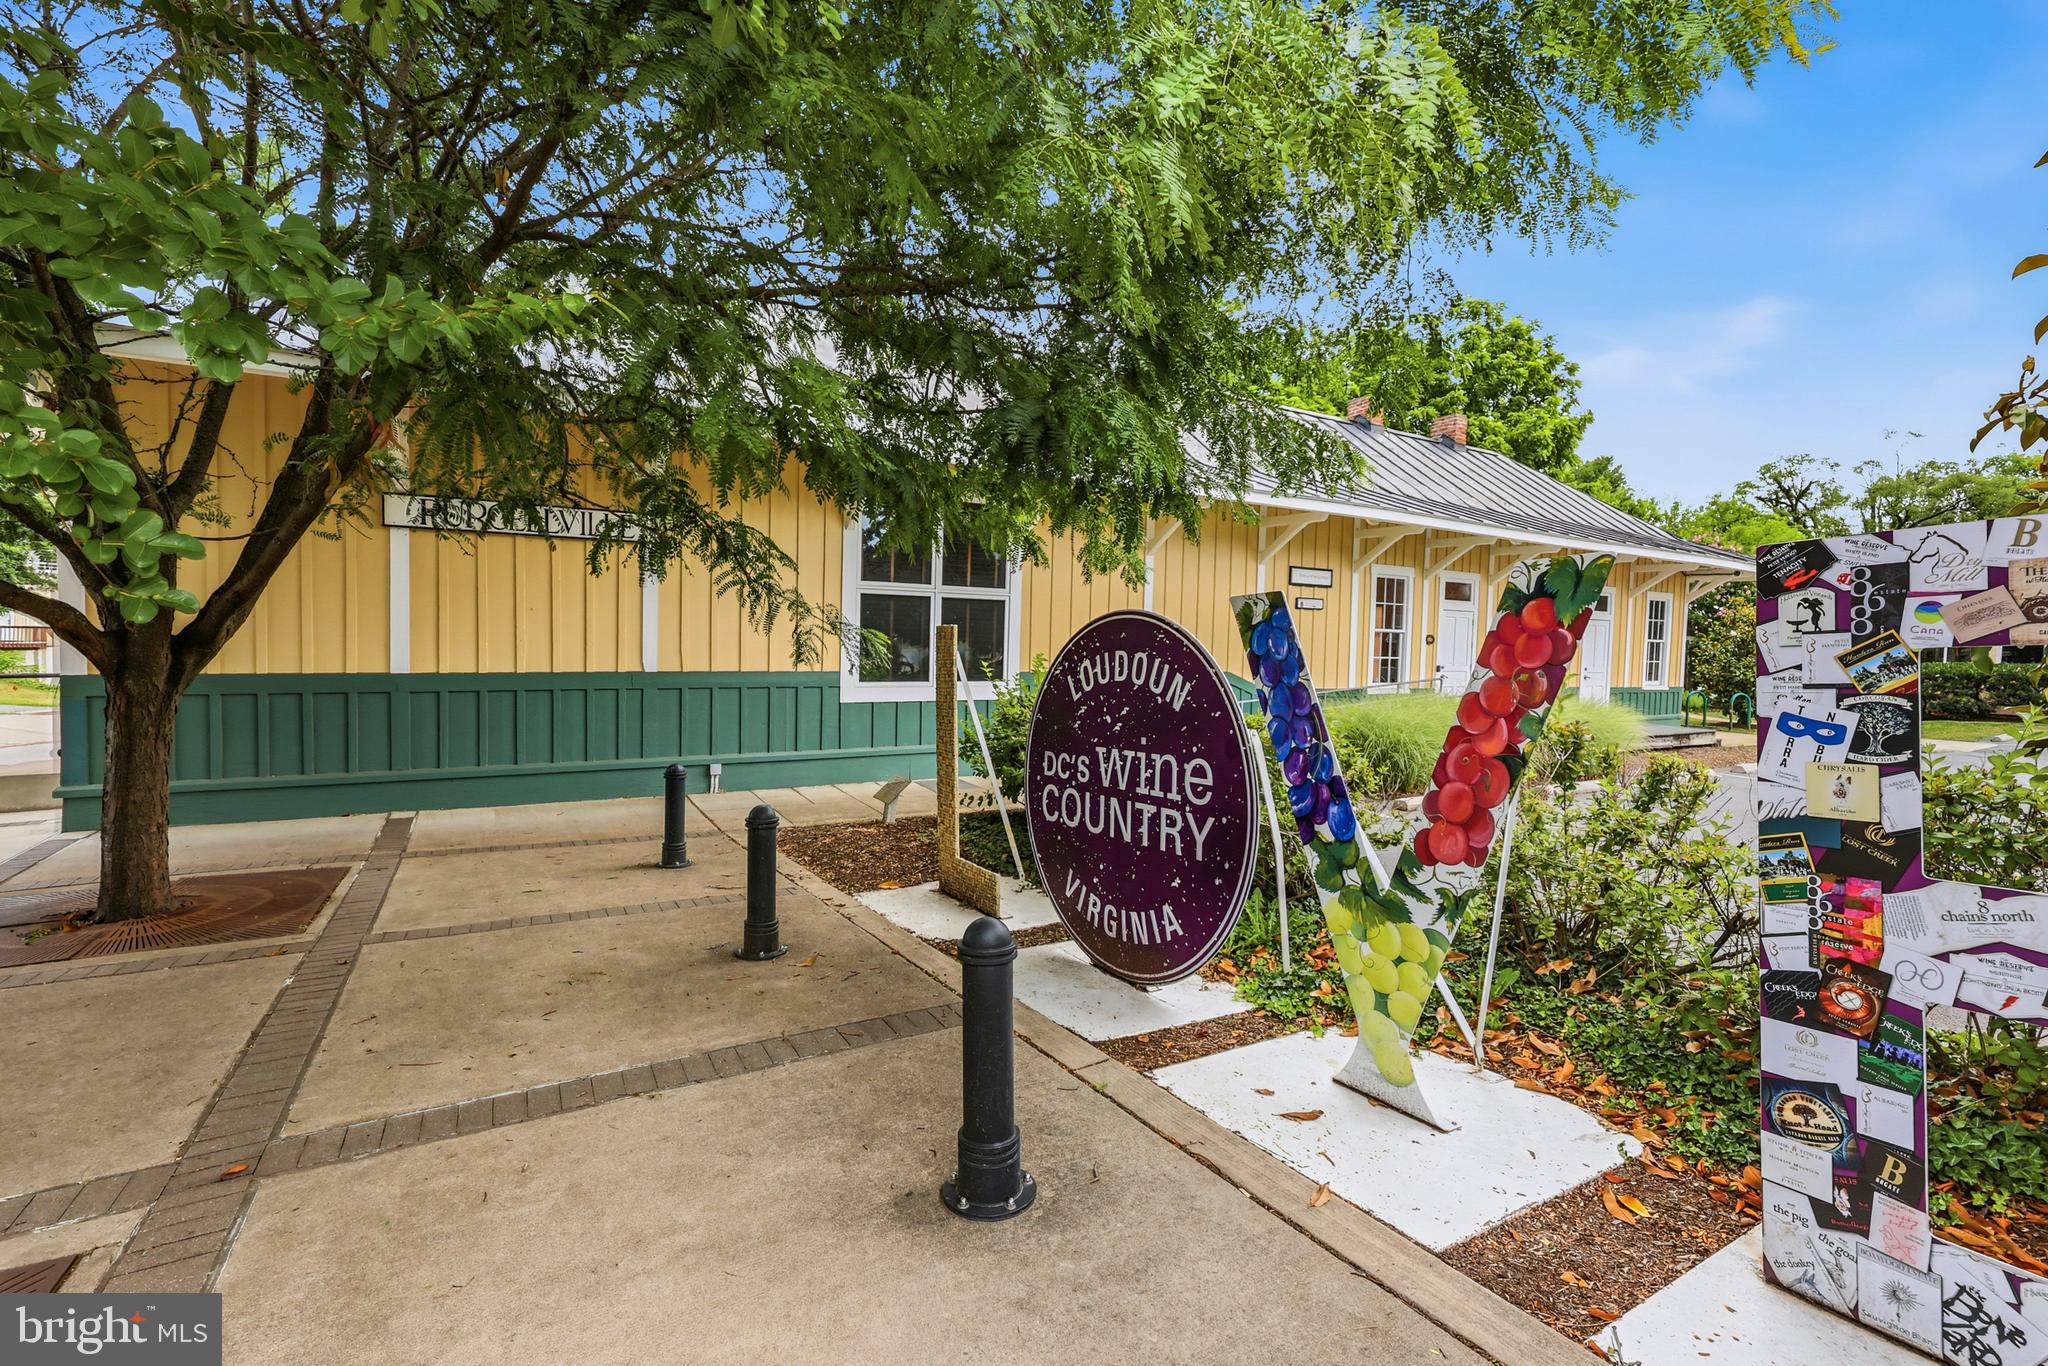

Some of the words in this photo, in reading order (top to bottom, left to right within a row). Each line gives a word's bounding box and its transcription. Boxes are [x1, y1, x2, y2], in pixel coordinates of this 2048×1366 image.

[1772, 556, 1807, 579] TENACITY
[1924, 567, 1985, 584] Mill
[1066, 650, 1192, 713] LOUDOUN
[1043, 750, 1091, 783] DC'S
[1817, 764, 1867, 773] CHRYSALIS
[1042, 783, 1215, 862] COUNTRY
[1841, 834, 1867, 851] LOST
[1064, 868, 1185, 945] VIRGINIA
[1977, 900, 1990, 914] 8
[1820, 914, 1854, 926] estate
[1941, 910, 1988, 923] chains
[1991, 909, 2036, 923] north
[1813, 1123, 1839, 1133] Head
[1878, 1153, 1907, 1186] B
[1773, 1203, 1790, 1217] the
[1791, 1212, 1809, 1229] pig
[1818, 1232, 1835, 1248] the
[1773, 1258, 1786, 1269] the
[1787, 1258, 1815, 1271] donkey
[1861, 1308, 1911, 1337] Sauvignon
[1911, 1331, 1940, 1349] Blanc
